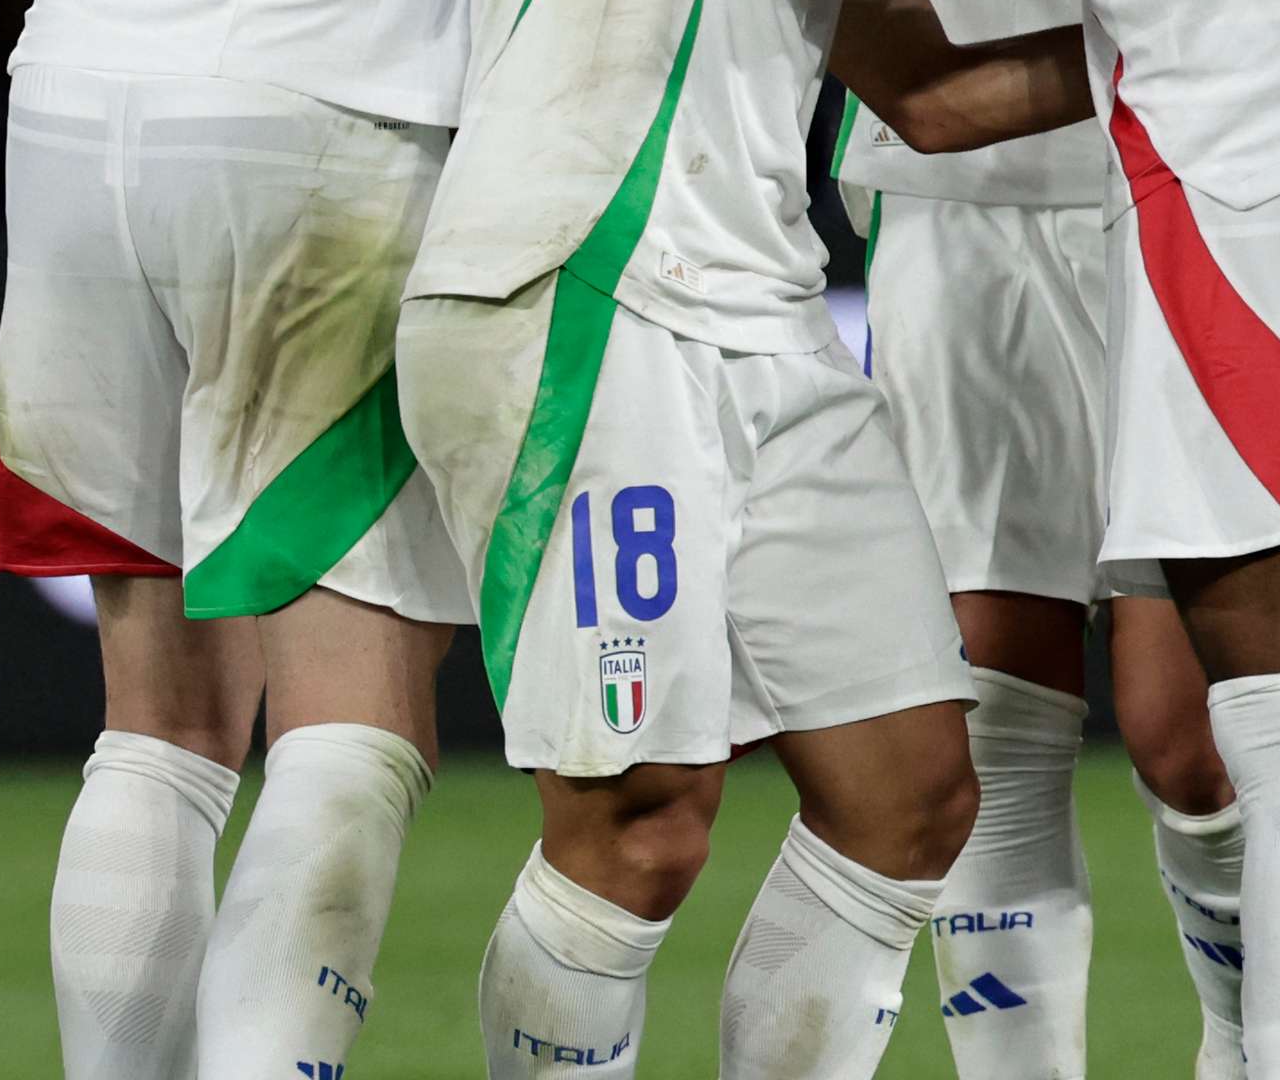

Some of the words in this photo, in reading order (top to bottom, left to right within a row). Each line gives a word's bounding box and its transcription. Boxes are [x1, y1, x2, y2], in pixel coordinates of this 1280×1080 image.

[570, 485, 678, 628] 18
[603, 658, 642, 675] ITALIA
[513, 1028, 630, 1066] ITALIA
